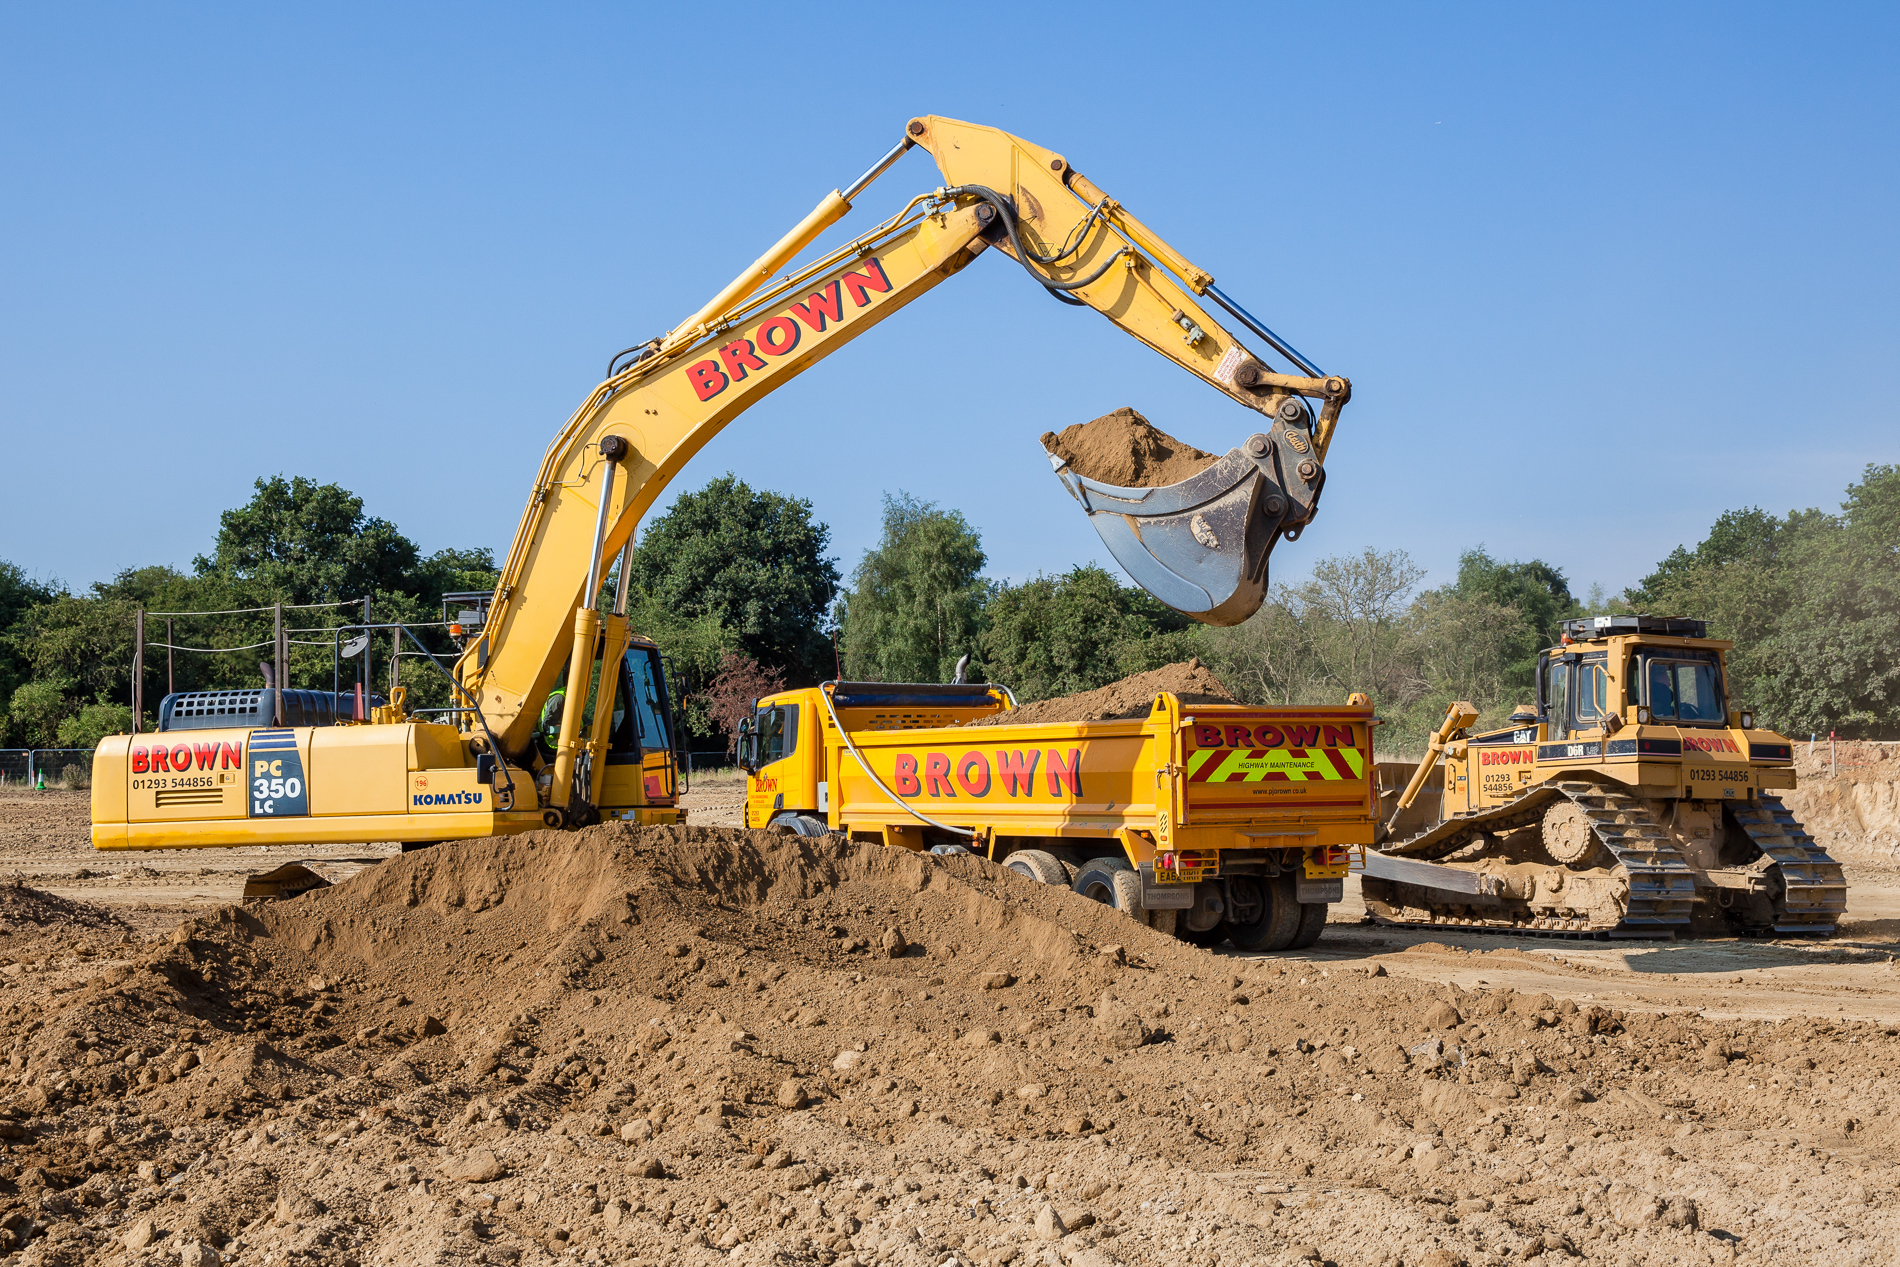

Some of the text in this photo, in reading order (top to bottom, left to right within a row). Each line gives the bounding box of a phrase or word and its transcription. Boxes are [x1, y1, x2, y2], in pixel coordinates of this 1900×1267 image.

[685, 257, 893, 402] BROWN
[1194, 725, 1356, 748] BROWN
[1513, 730, 1532, 744] CAT
[132, 741, 242, 774] BROWN
[1481, 750, 1533, 766] BROWN
[1567, 745, 1584, 757] D6R
[254, 760, 282, 778] PC
[1269, 761, 1315, 769] MAINTENANCE
[894, 748, 1084, 798] BROWN
[1485, 774, 1511, 783] 01293
[1690, 769, 1749, 782] 01293 544856
[133, 777, 213, 790] 01293 544856
[253, 777, 301, 799] 350
[755, 778, 778, 793] BROWN
[1483, 783, 1513, 792] 544856
[413, 790, 482, 806] KOMATSU
[1252, 786, 1307, 796] www.pjbrown.co.uk
[254, 800, 274, 814] LC
[1146, 892, 1190, 901] THOMPSONS
